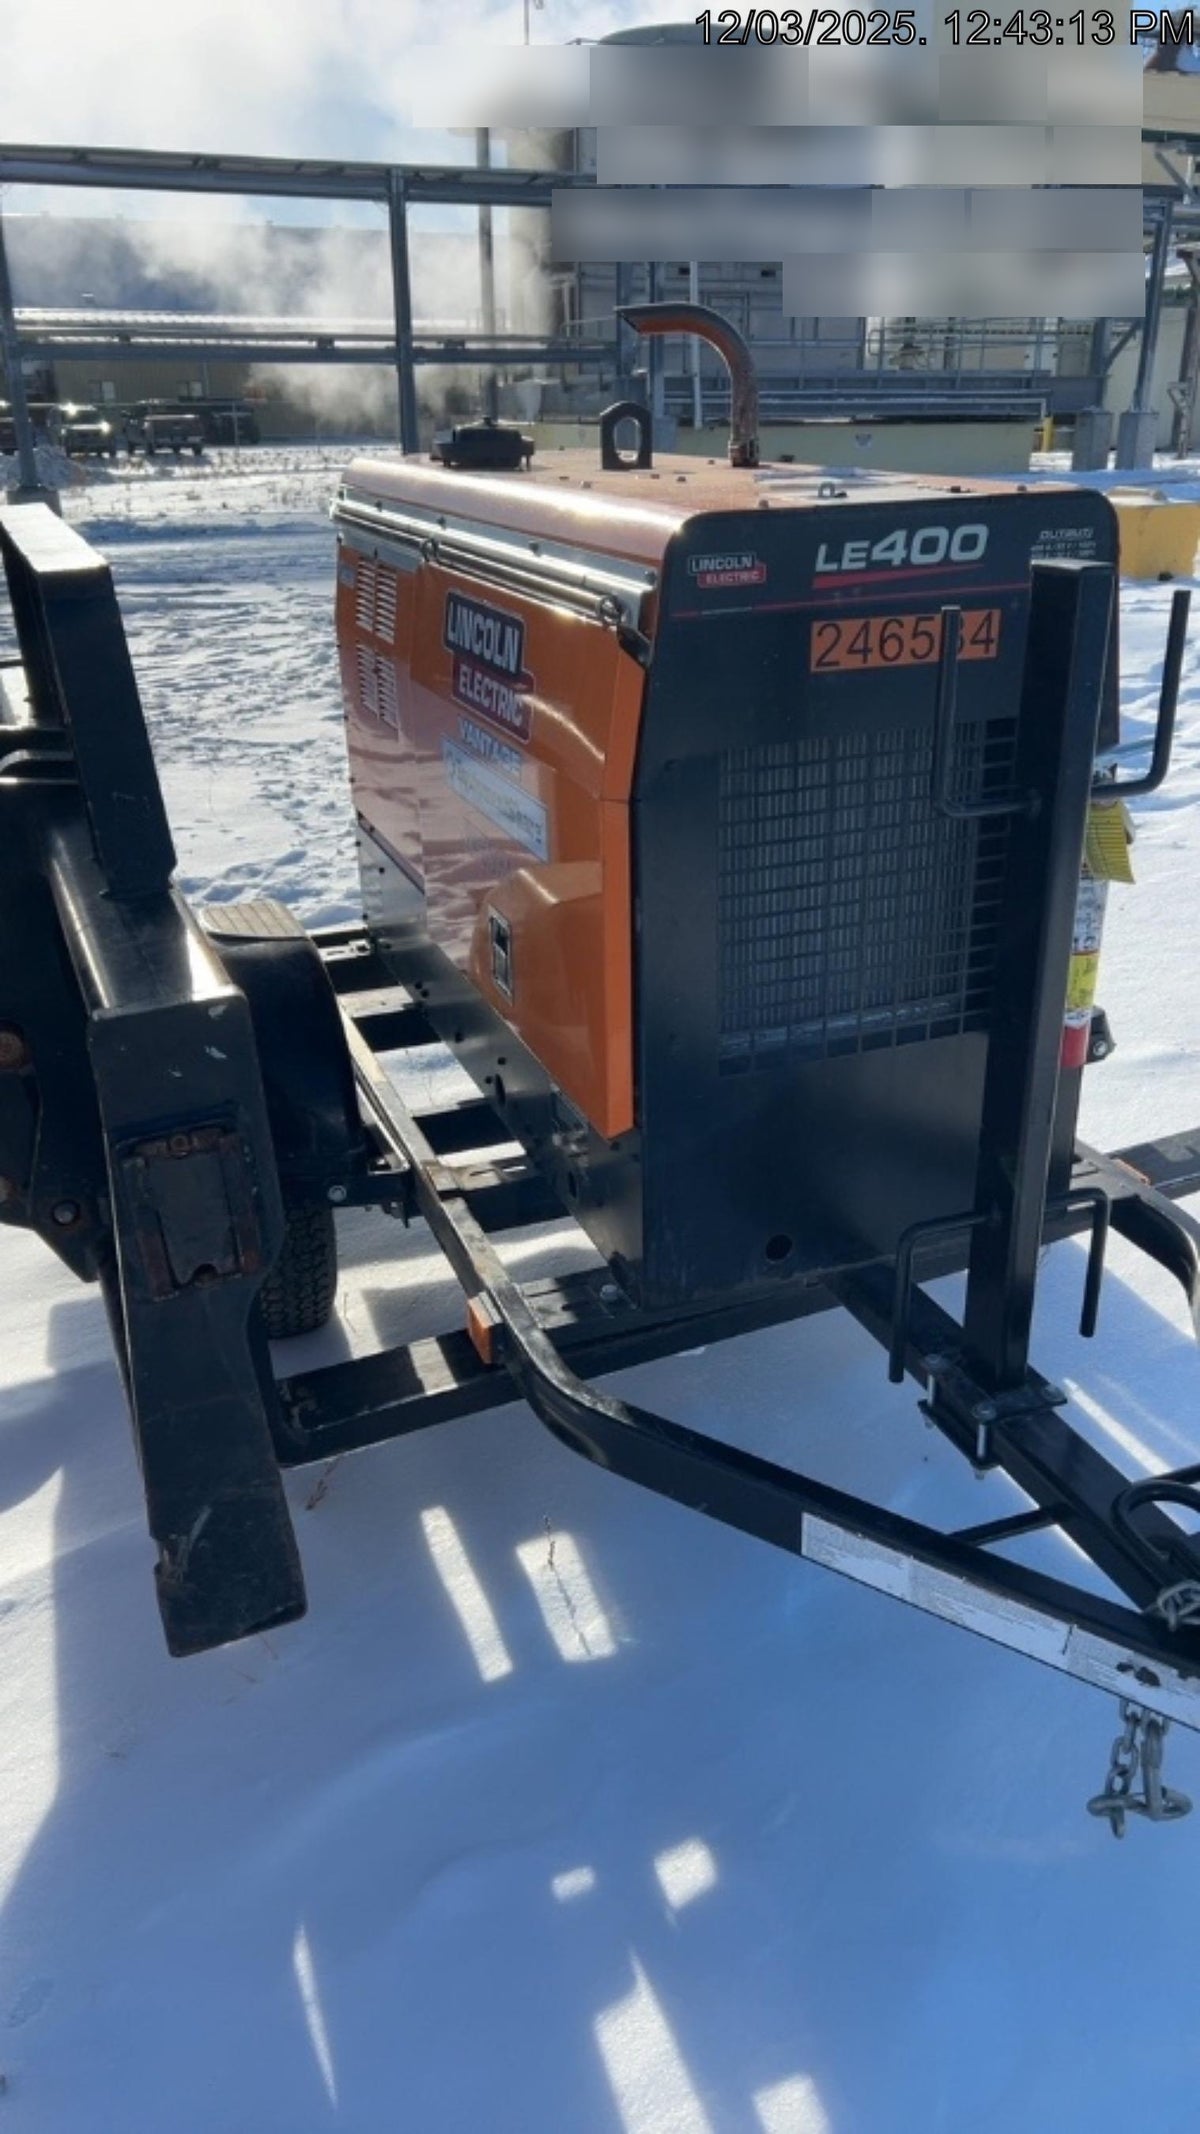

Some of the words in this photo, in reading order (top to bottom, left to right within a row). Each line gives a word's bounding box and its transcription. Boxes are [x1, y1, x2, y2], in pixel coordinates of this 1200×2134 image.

[691, 555, 753, 573] LINCOLN
[814, 523, 990, 572] LE400
[705, 569, 761, 585] ELECTRIC
[447, 600, 520, 675] LINCOLN
[815, 611, 995, 668] 24654
[458, 663, 524, 728] ELECTRIC
